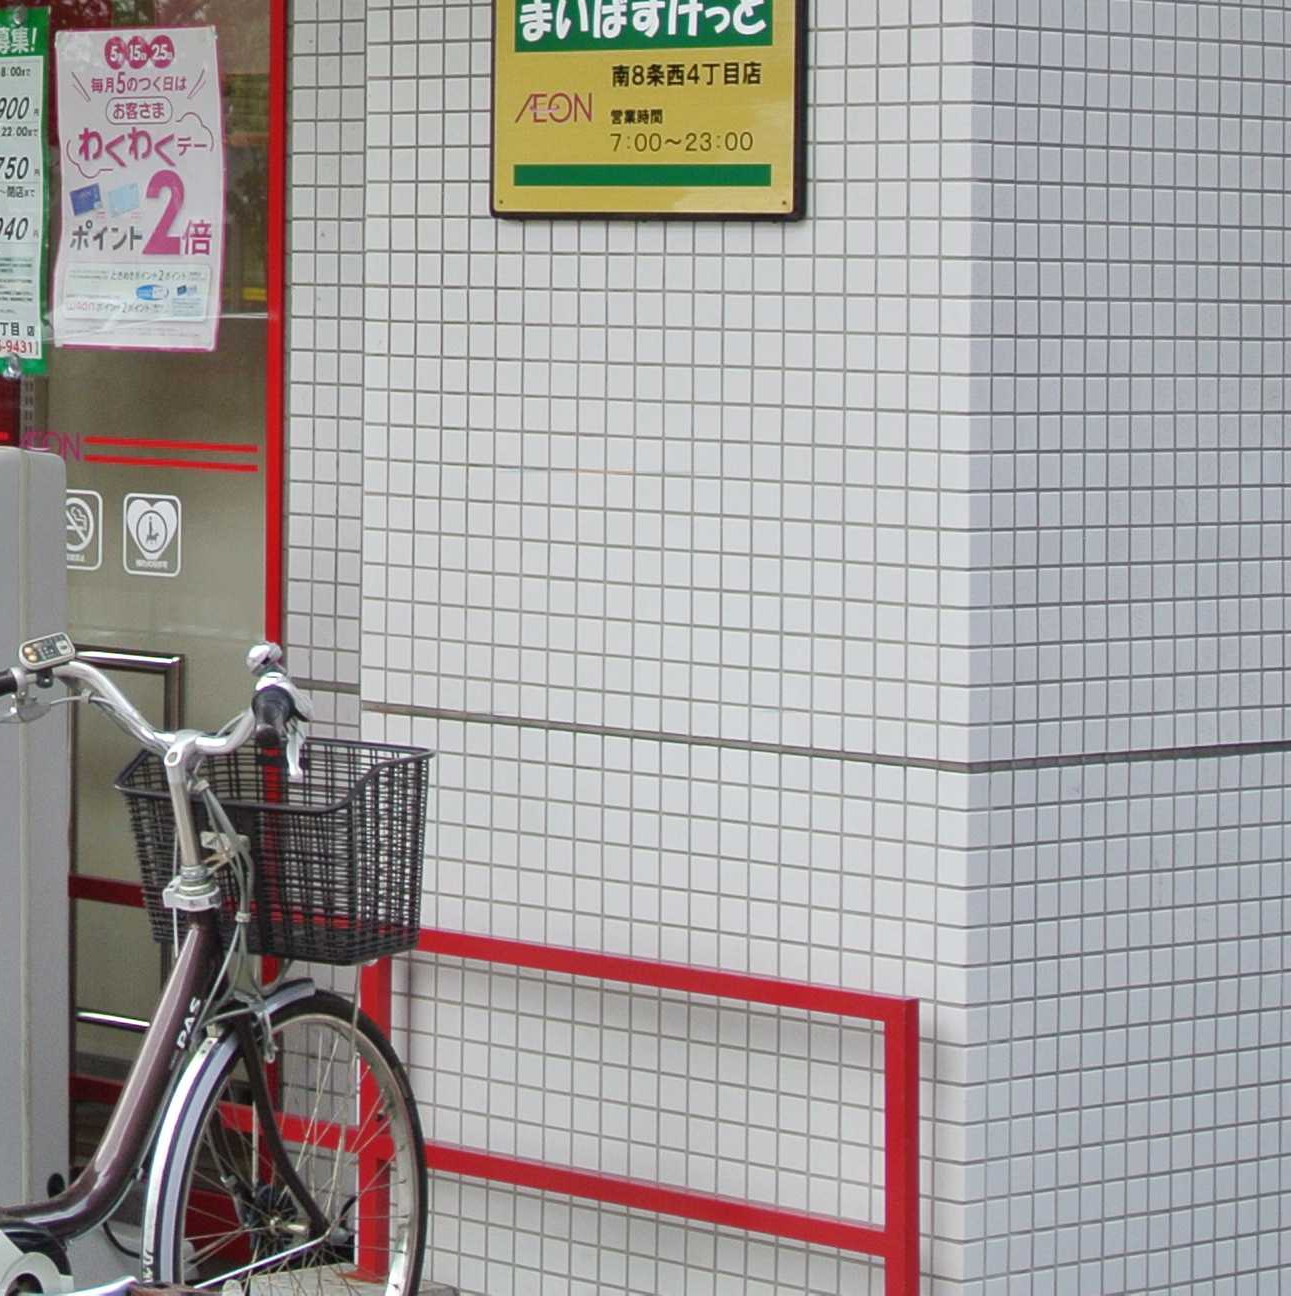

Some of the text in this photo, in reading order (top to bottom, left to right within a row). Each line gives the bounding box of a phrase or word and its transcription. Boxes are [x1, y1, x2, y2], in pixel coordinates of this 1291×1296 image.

[91, 72, 187, 94] 毎月5のつく日は
[611, 62, 762, 87] 南8条西4丁目店
[112, 102, 165, 120] お客さま
[610, 109, 664, 125] 営業時間
[78, 127, 207, 167] わくわくデー
[176, 997, 201, 1049] PAS
